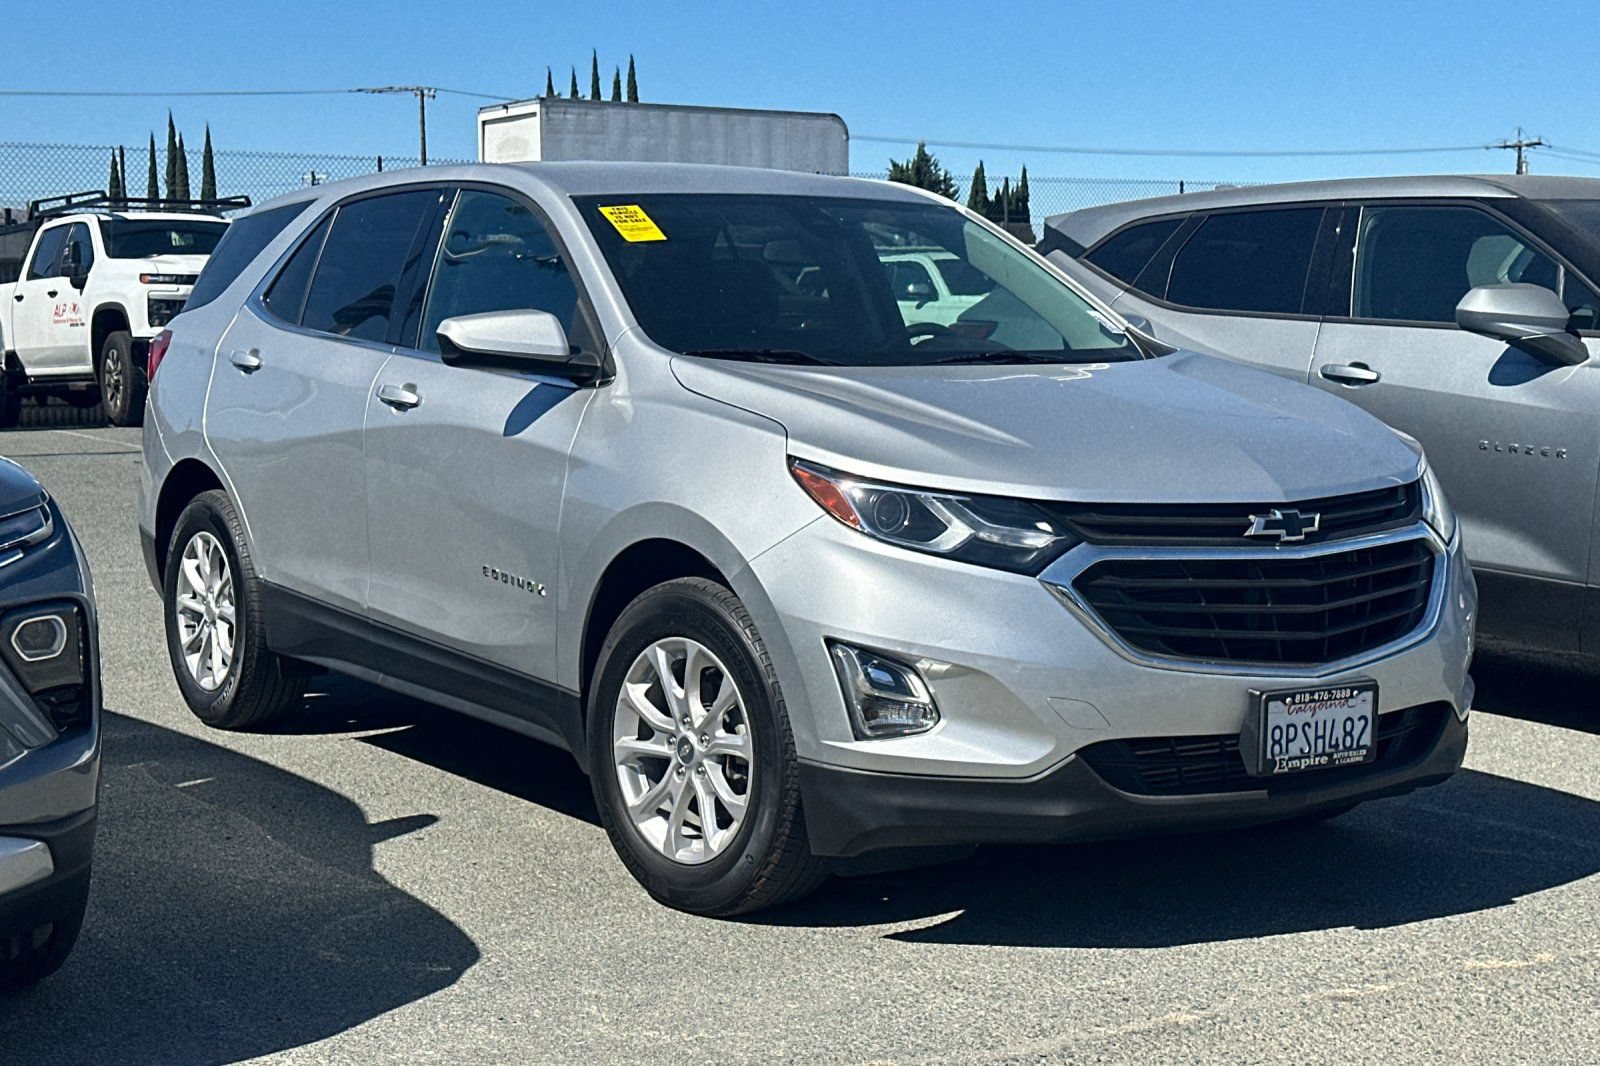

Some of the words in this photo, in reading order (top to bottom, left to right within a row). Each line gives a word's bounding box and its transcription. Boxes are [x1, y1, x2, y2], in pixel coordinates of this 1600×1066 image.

[1478, 440, 1567, 460] BLAZER
[482, 564, 546, 597] EQUINOX
[1287, 699, 1356, 718] California
[1271, 715, 1369, 759] 8PSH482
[1273, 754, 1329, 774] Empire
